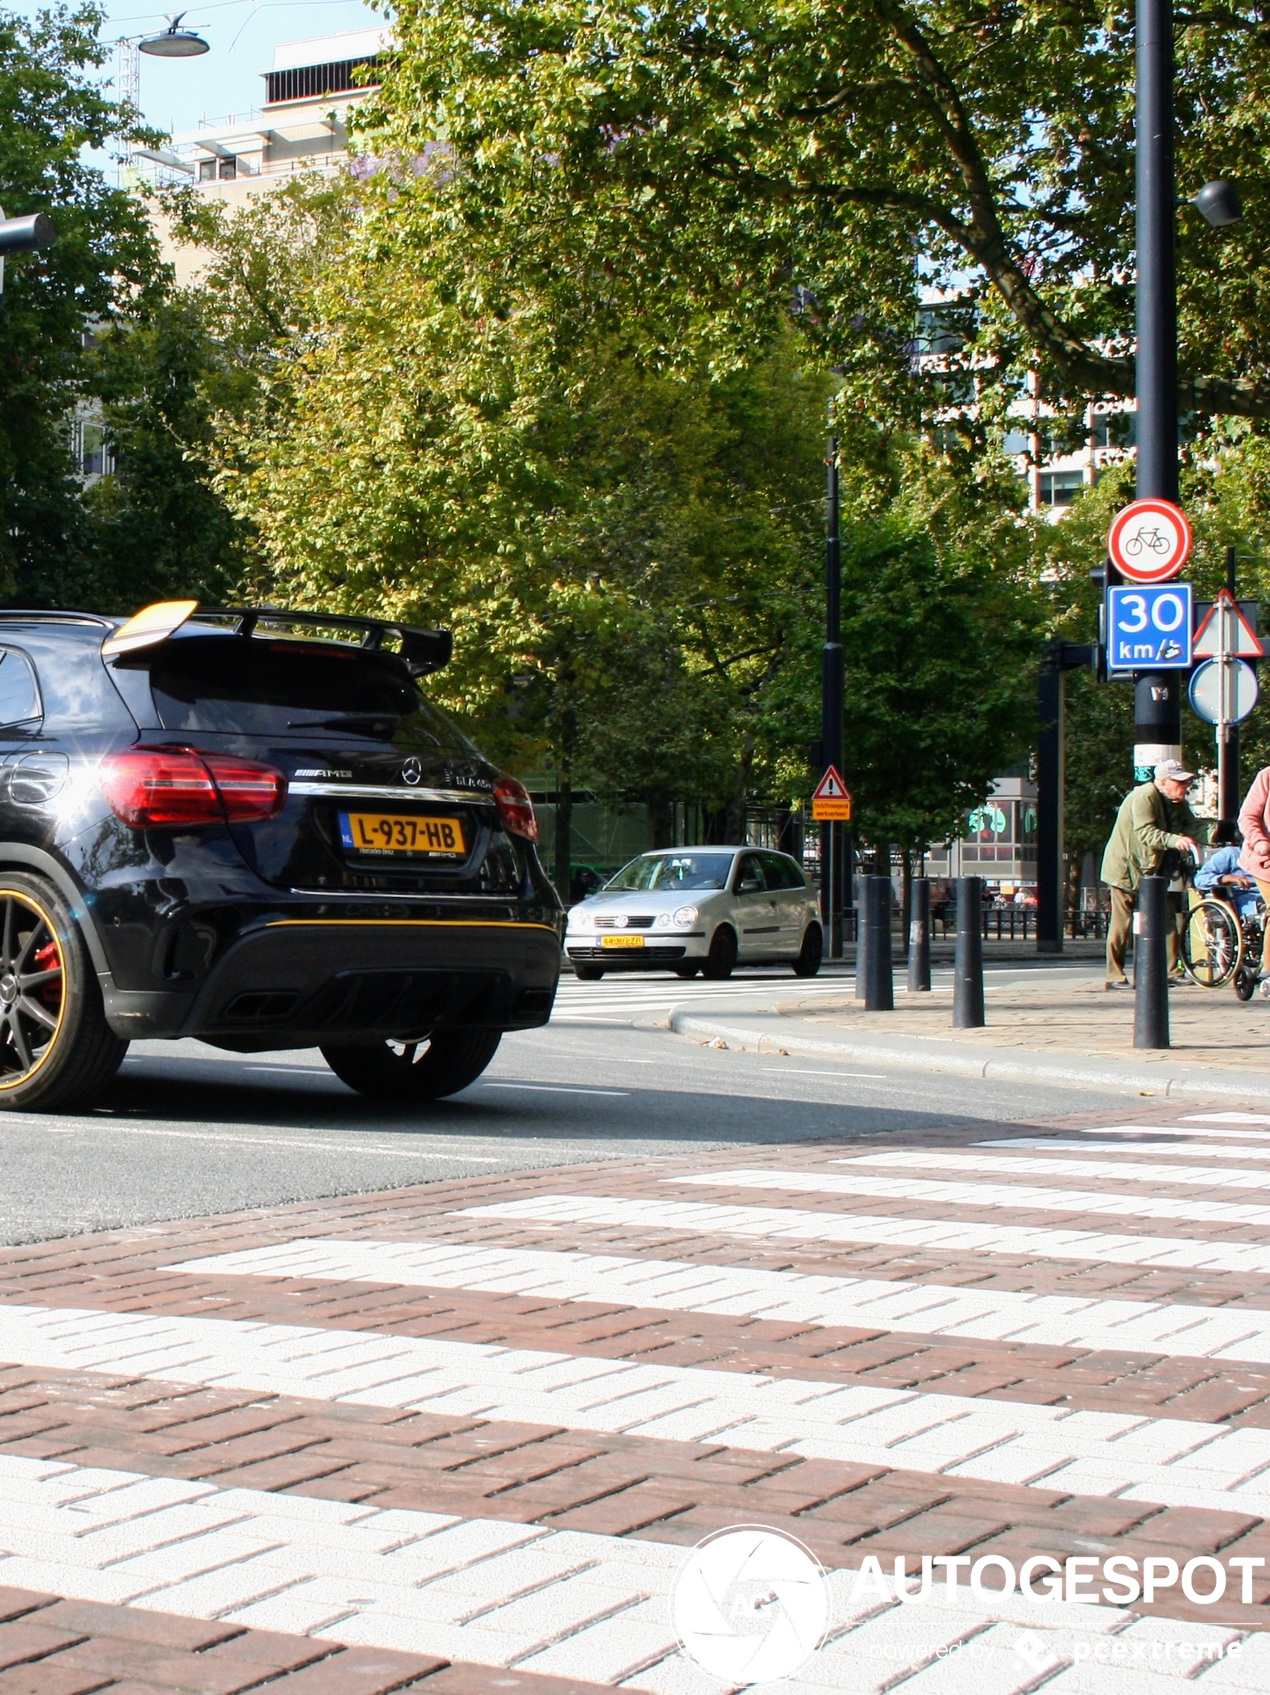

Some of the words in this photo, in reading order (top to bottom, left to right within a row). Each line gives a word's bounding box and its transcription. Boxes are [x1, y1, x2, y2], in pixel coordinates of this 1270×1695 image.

[1118, 593, 1184, 633] 30
[341, 834, 353, 843] NL
[358, 819, 456, 848] L-937-HB
